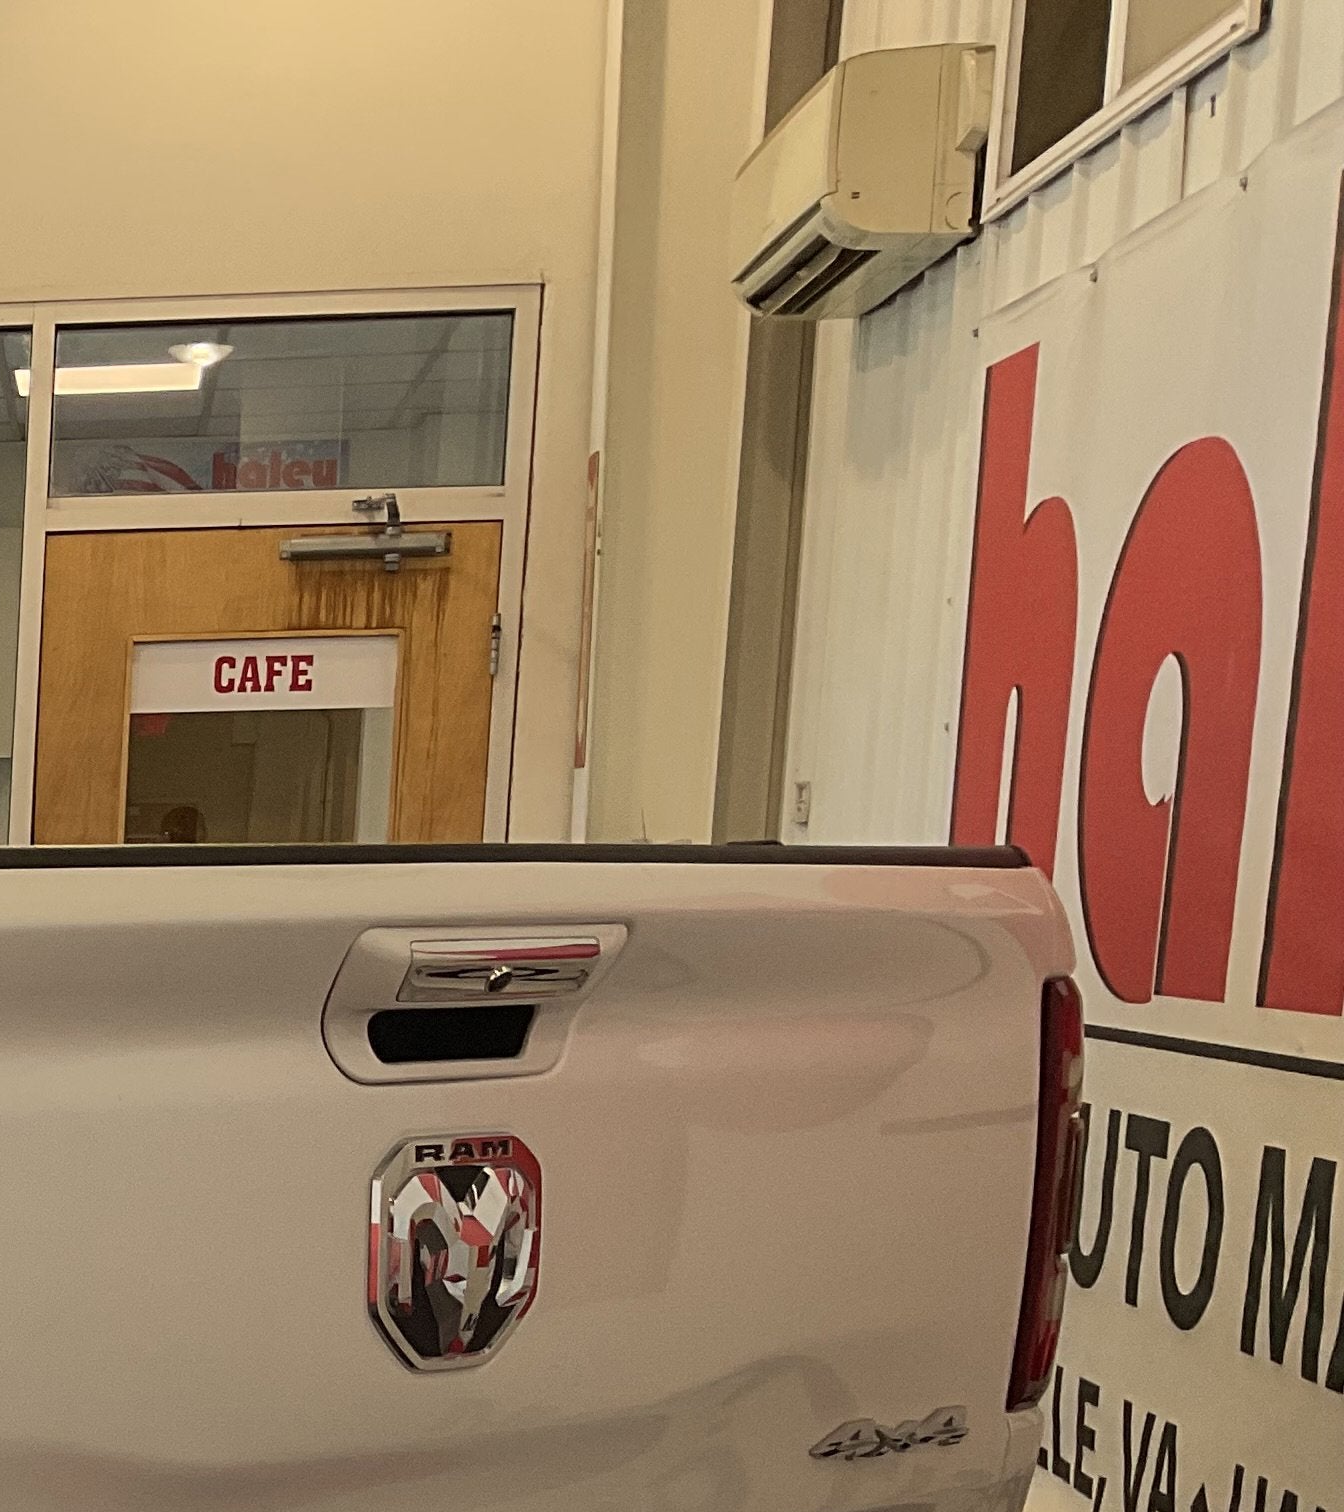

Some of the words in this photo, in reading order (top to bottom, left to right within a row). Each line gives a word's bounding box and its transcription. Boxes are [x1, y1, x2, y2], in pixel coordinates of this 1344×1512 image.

[214, 655, 314, 694] CAFE
[415, 1141, 511, 1162] RAM
[1068, 1103, 1224, 1331] UTO
[1240, 1145, 1344, 1395] M
